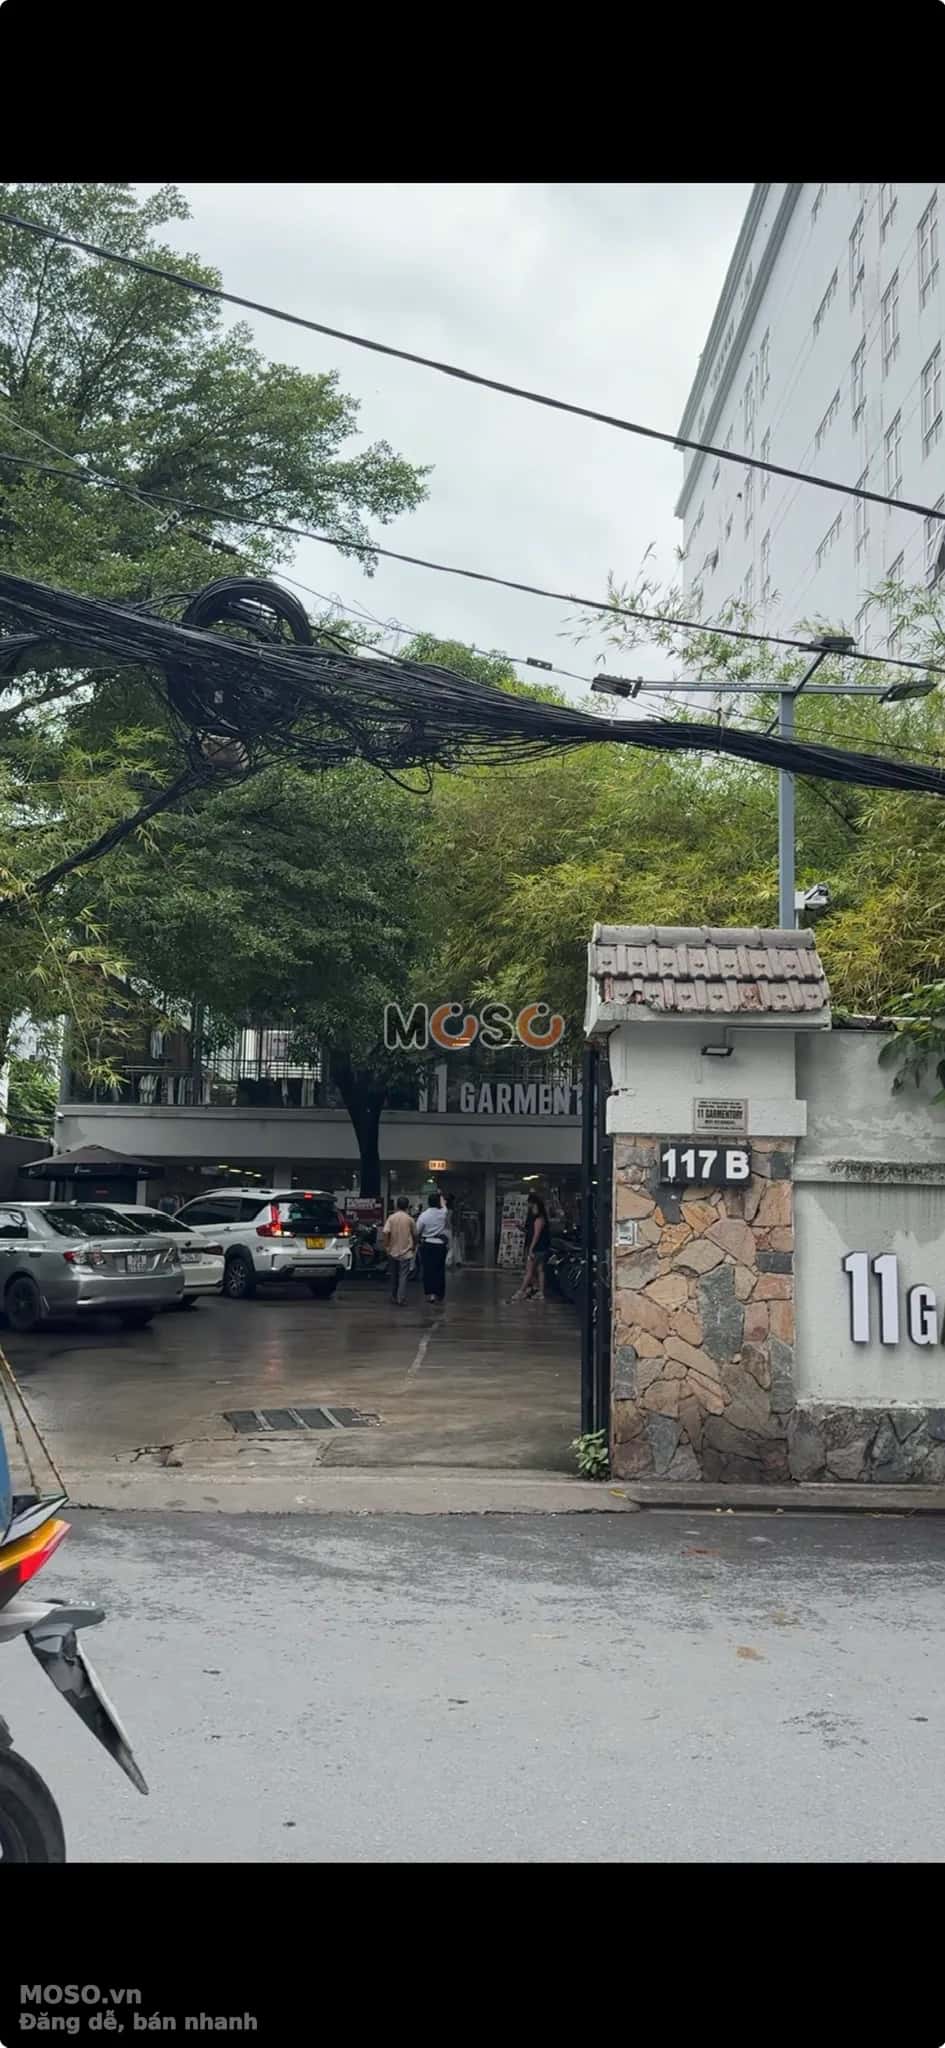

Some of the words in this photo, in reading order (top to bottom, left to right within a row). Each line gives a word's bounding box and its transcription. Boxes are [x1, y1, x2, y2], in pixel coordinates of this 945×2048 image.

[661, 1148, 718, 1179] 117
[725, 1150, 750, 1180] B
[842, 1250, 899, 1345] 11
